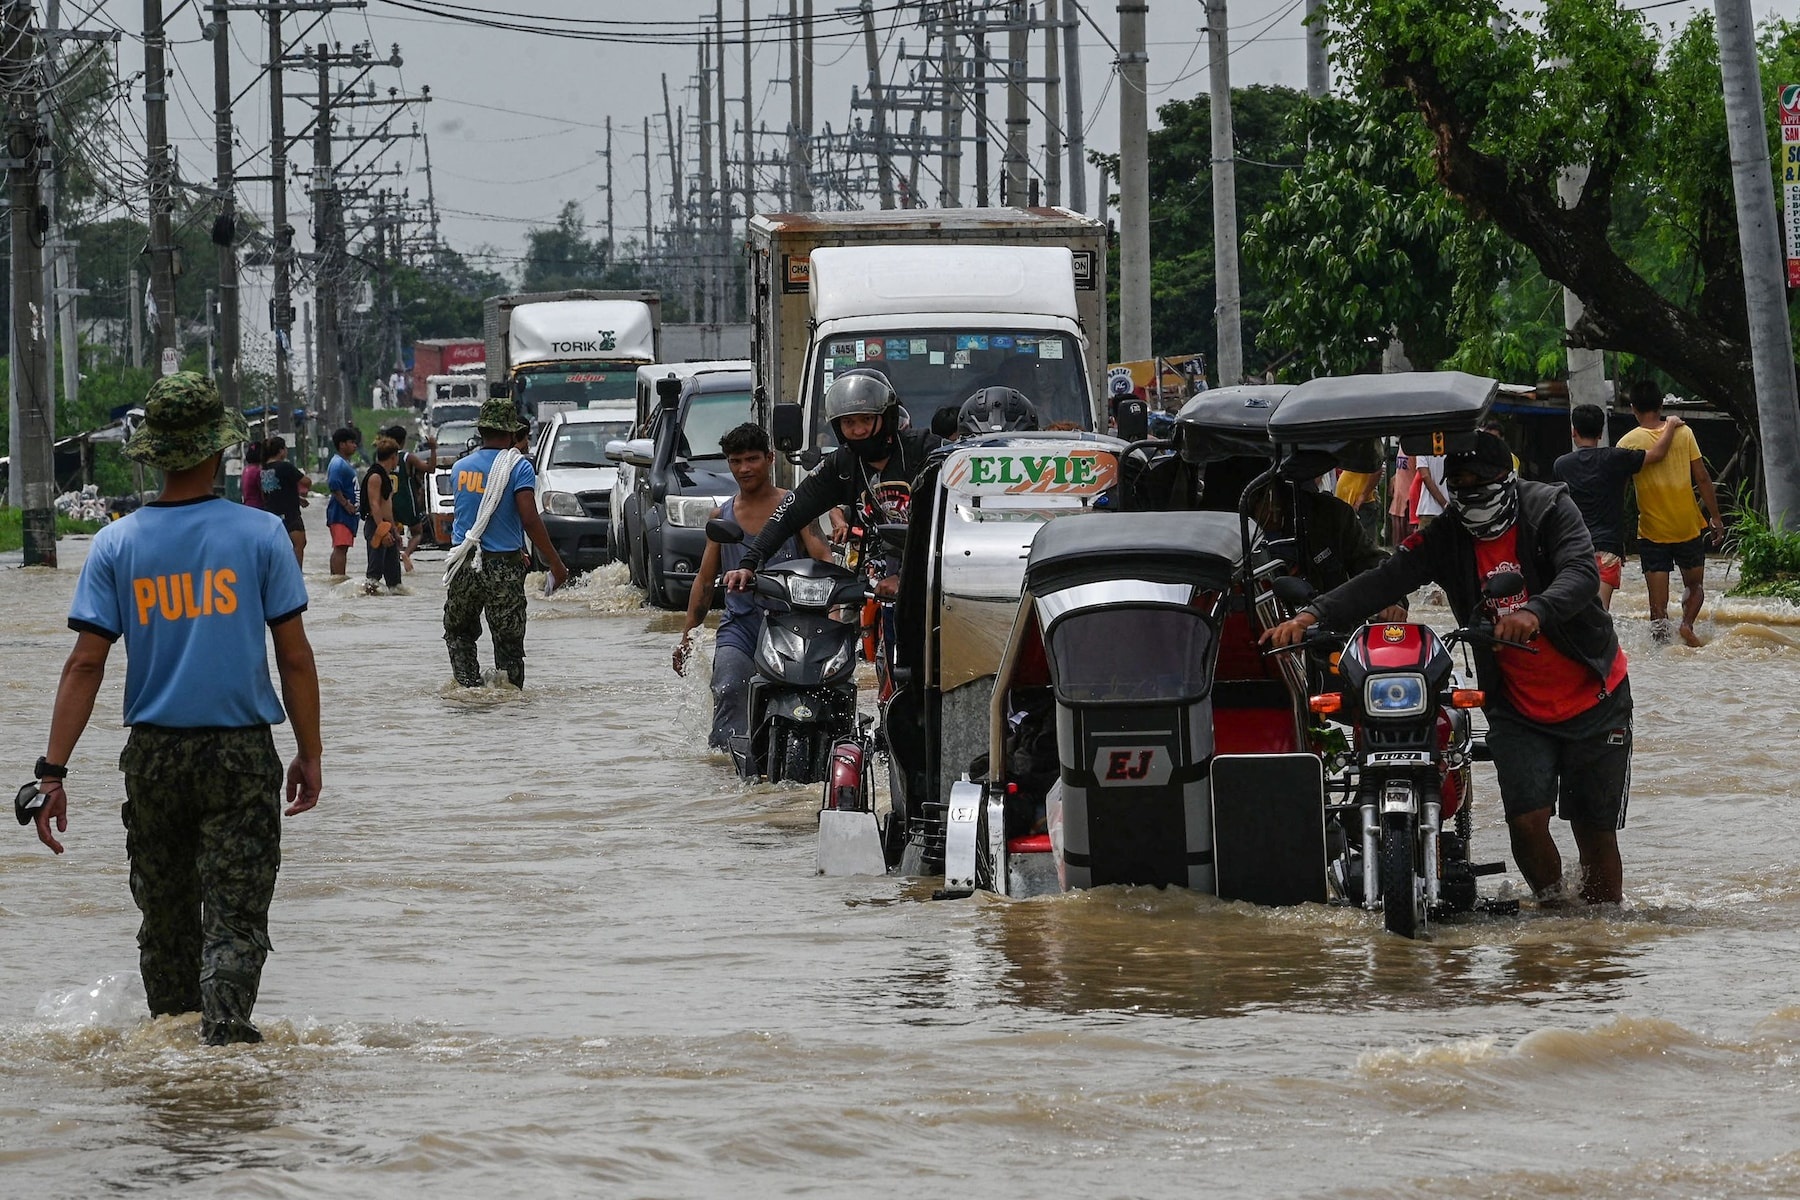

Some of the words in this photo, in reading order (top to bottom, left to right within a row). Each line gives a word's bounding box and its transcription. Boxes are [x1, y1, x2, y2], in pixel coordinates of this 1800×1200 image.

[791, 265, 810, 274] CHA
[552, 341, 598, 352] TORIK
[458, 471, 486, 494] PUL
[969, 456, 1098, 485] ELVIE
[133, 568, 238, 625] PULIS
[1105, 750, 1155, 780] EJ
